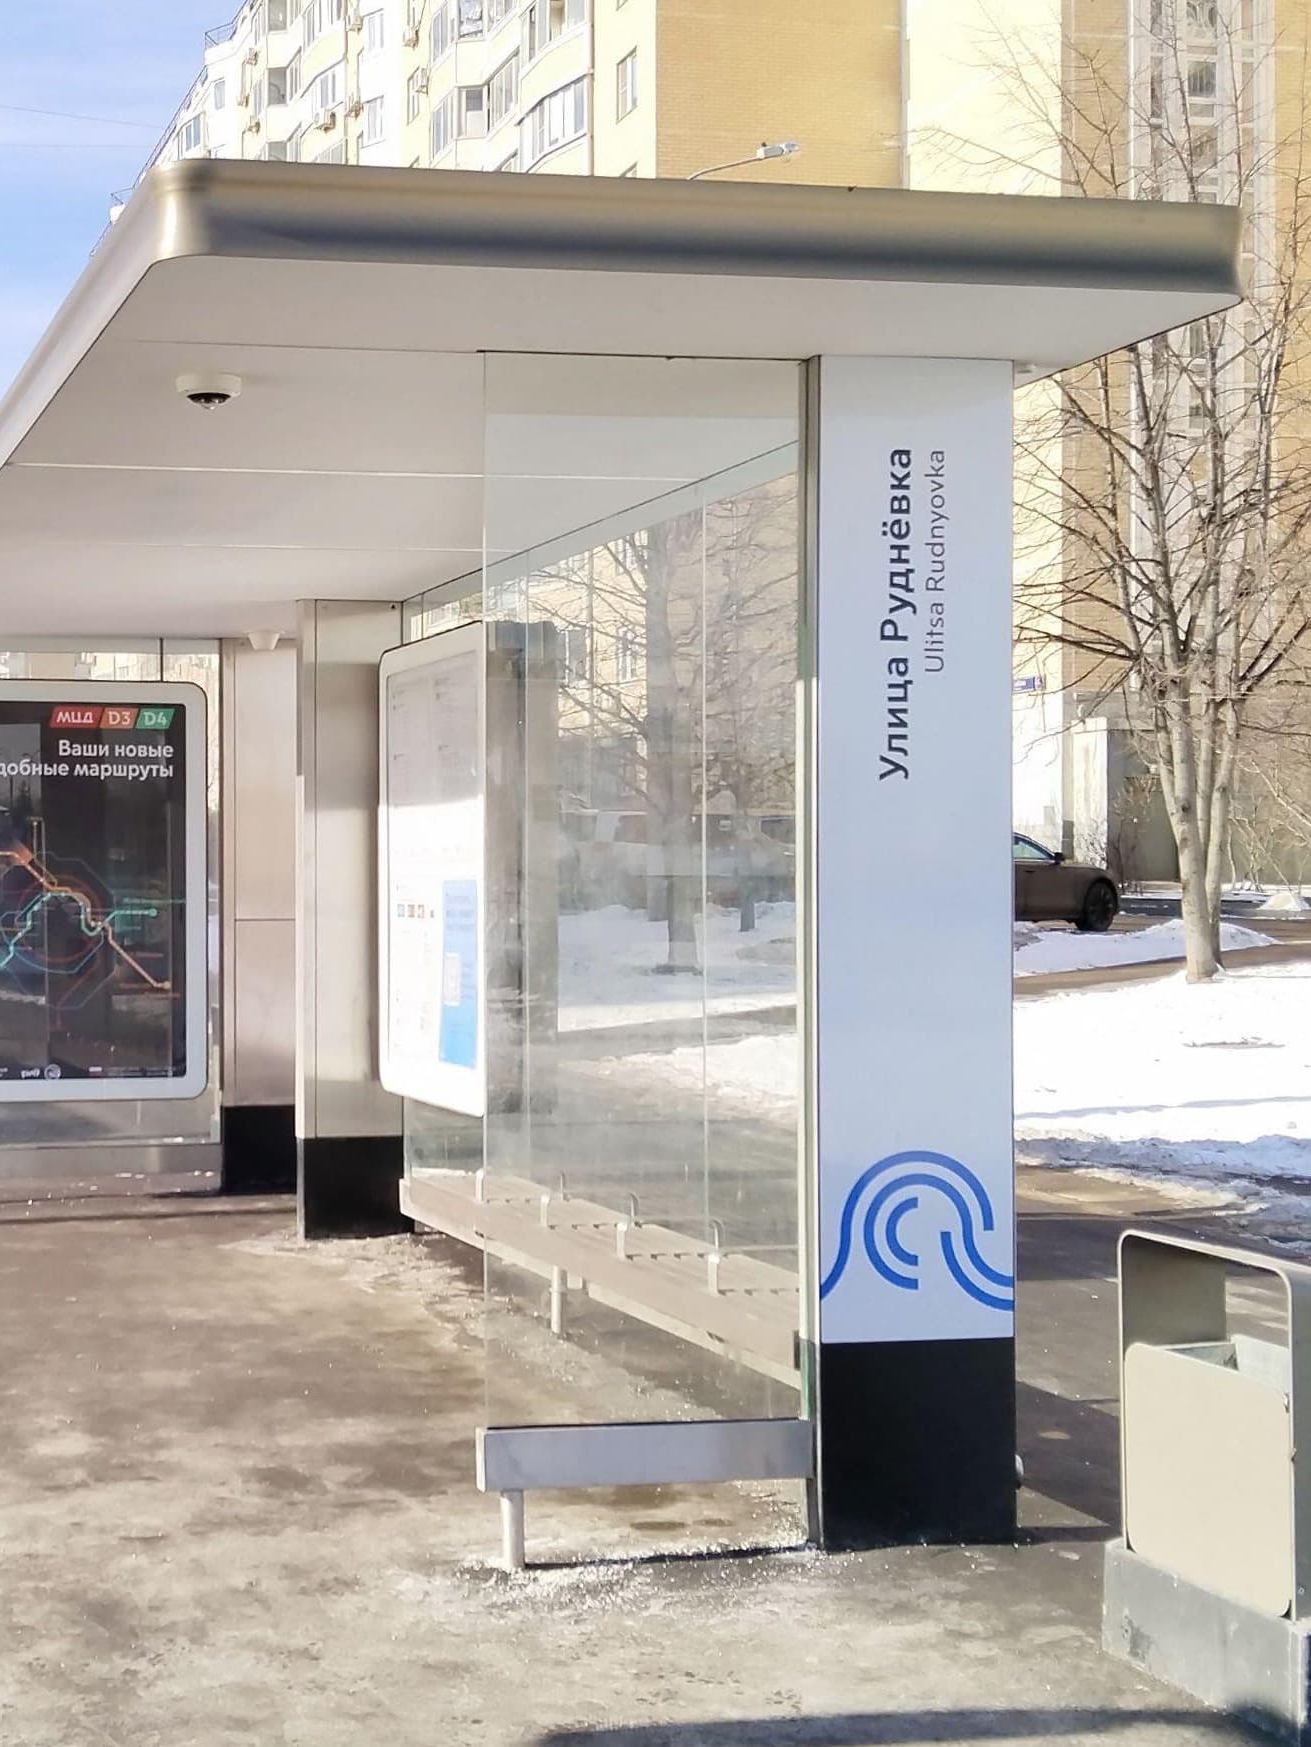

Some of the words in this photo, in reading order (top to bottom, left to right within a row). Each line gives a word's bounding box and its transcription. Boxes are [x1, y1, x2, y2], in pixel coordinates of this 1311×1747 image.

[880, 449, 917, 642] Руднёвка
[924, 450, 950, 592] Rudnyovka
[924, 602, 945, 673] Ulitsa
[56, 710, 94, 725] МЦД
[107, 710, 132, 726] D3
[143, 710, 168, 727] D4
[58, 739, 109, 758] Ваши
[115, 742, 174, 759] новые
[879, 657, 913, 781] Улица
[73, 763, 174, 782] маршруты
